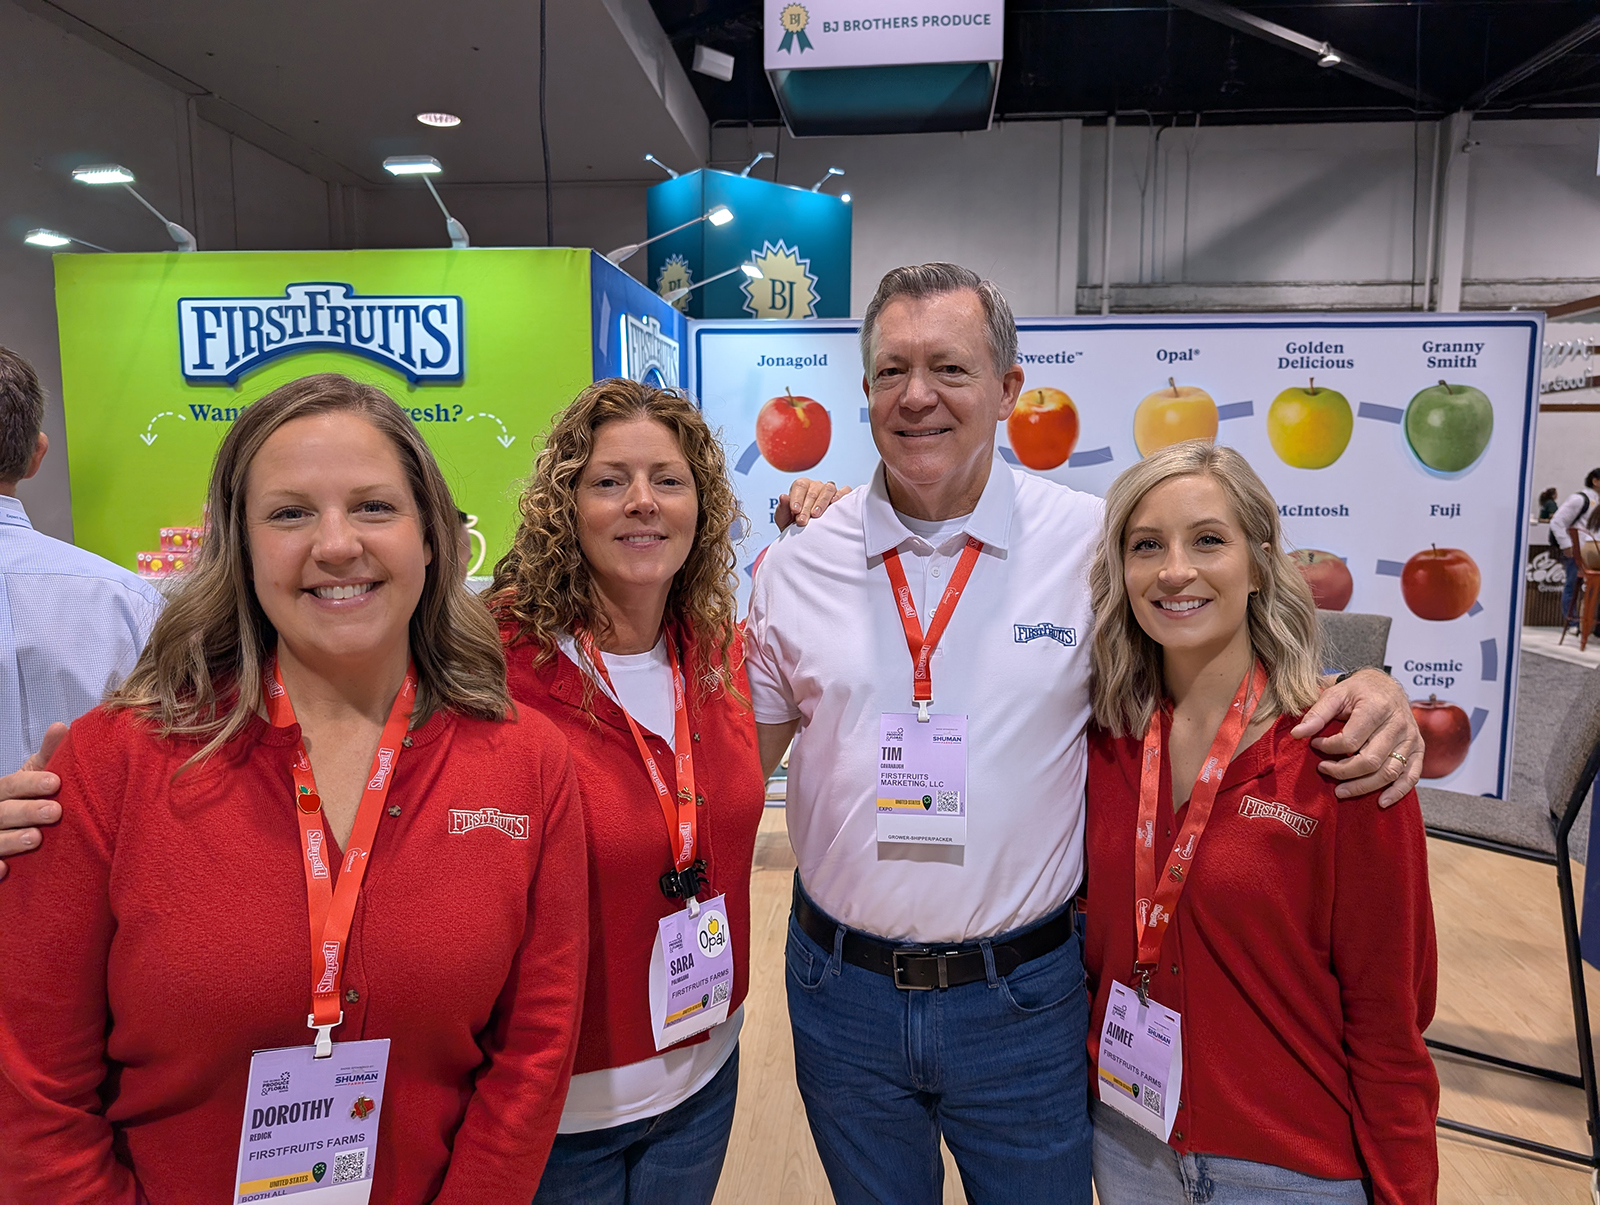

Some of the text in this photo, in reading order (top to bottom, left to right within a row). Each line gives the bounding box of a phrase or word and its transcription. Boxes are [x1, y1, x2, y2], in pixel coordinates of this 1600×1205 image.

[789, 13, 801, 27] BJ
[823, 14, 991, 33] BJ BROTHERS PRODUCE
[769, 278, 796, 319] BJ
[190, 290, 451, 370] FIRSTFRUITS
[1286, 341, 1344, 354] Golden
[1422, 341, 1485, 355] Granny
[757, 354, 828, 369] Jonagold
[1278, 357, 1354, 369] Delicious
[1427, 355, 1477, 368] Smith
[1277, 504, 1349, 517] McIntosh
[1429, 504, 1461, 519] Fuji
[1017, 623, 1074, 644] FIRSTFRUITS
[1404, 660, 1463, 672] Cosmic
[1413, 674, 1454, 688] Crisp
[881, 747, 902, 761] TIM
[881, 772, 929, 780] FIRSTFRUITS
[881, 780, 927, 788] MARKETING,
[452, 810, 525, 836] FIRSTFRUITS
[1243, 798, 1312, 834] FIRSTFRUITS
[700, 925, 725, 952] Opal
[670, 953, 694, 976] SARA
[672, 969, 729, 999] FIRSTFRUITS FARMS
[1106, 1021, 1134, 1048] AIMEE
[1147, 1028, 1171, 1044] SHUMAN
[1104, 1049, 1161, 1088] FIRSTFRUITS FARMS
[335, 1073, 378, 1083] SHUMAN
[251, 1098, 334, 1129] DOROTHY
[249, 1131, 272, 1142] REDICK
[249, 1133, 365, 1161] FIRSTFRUITS FARMS
[270, 1175, 309, 1188] UNITED STATES
[242, 1190, 288, 1203] BOOTH ALL
